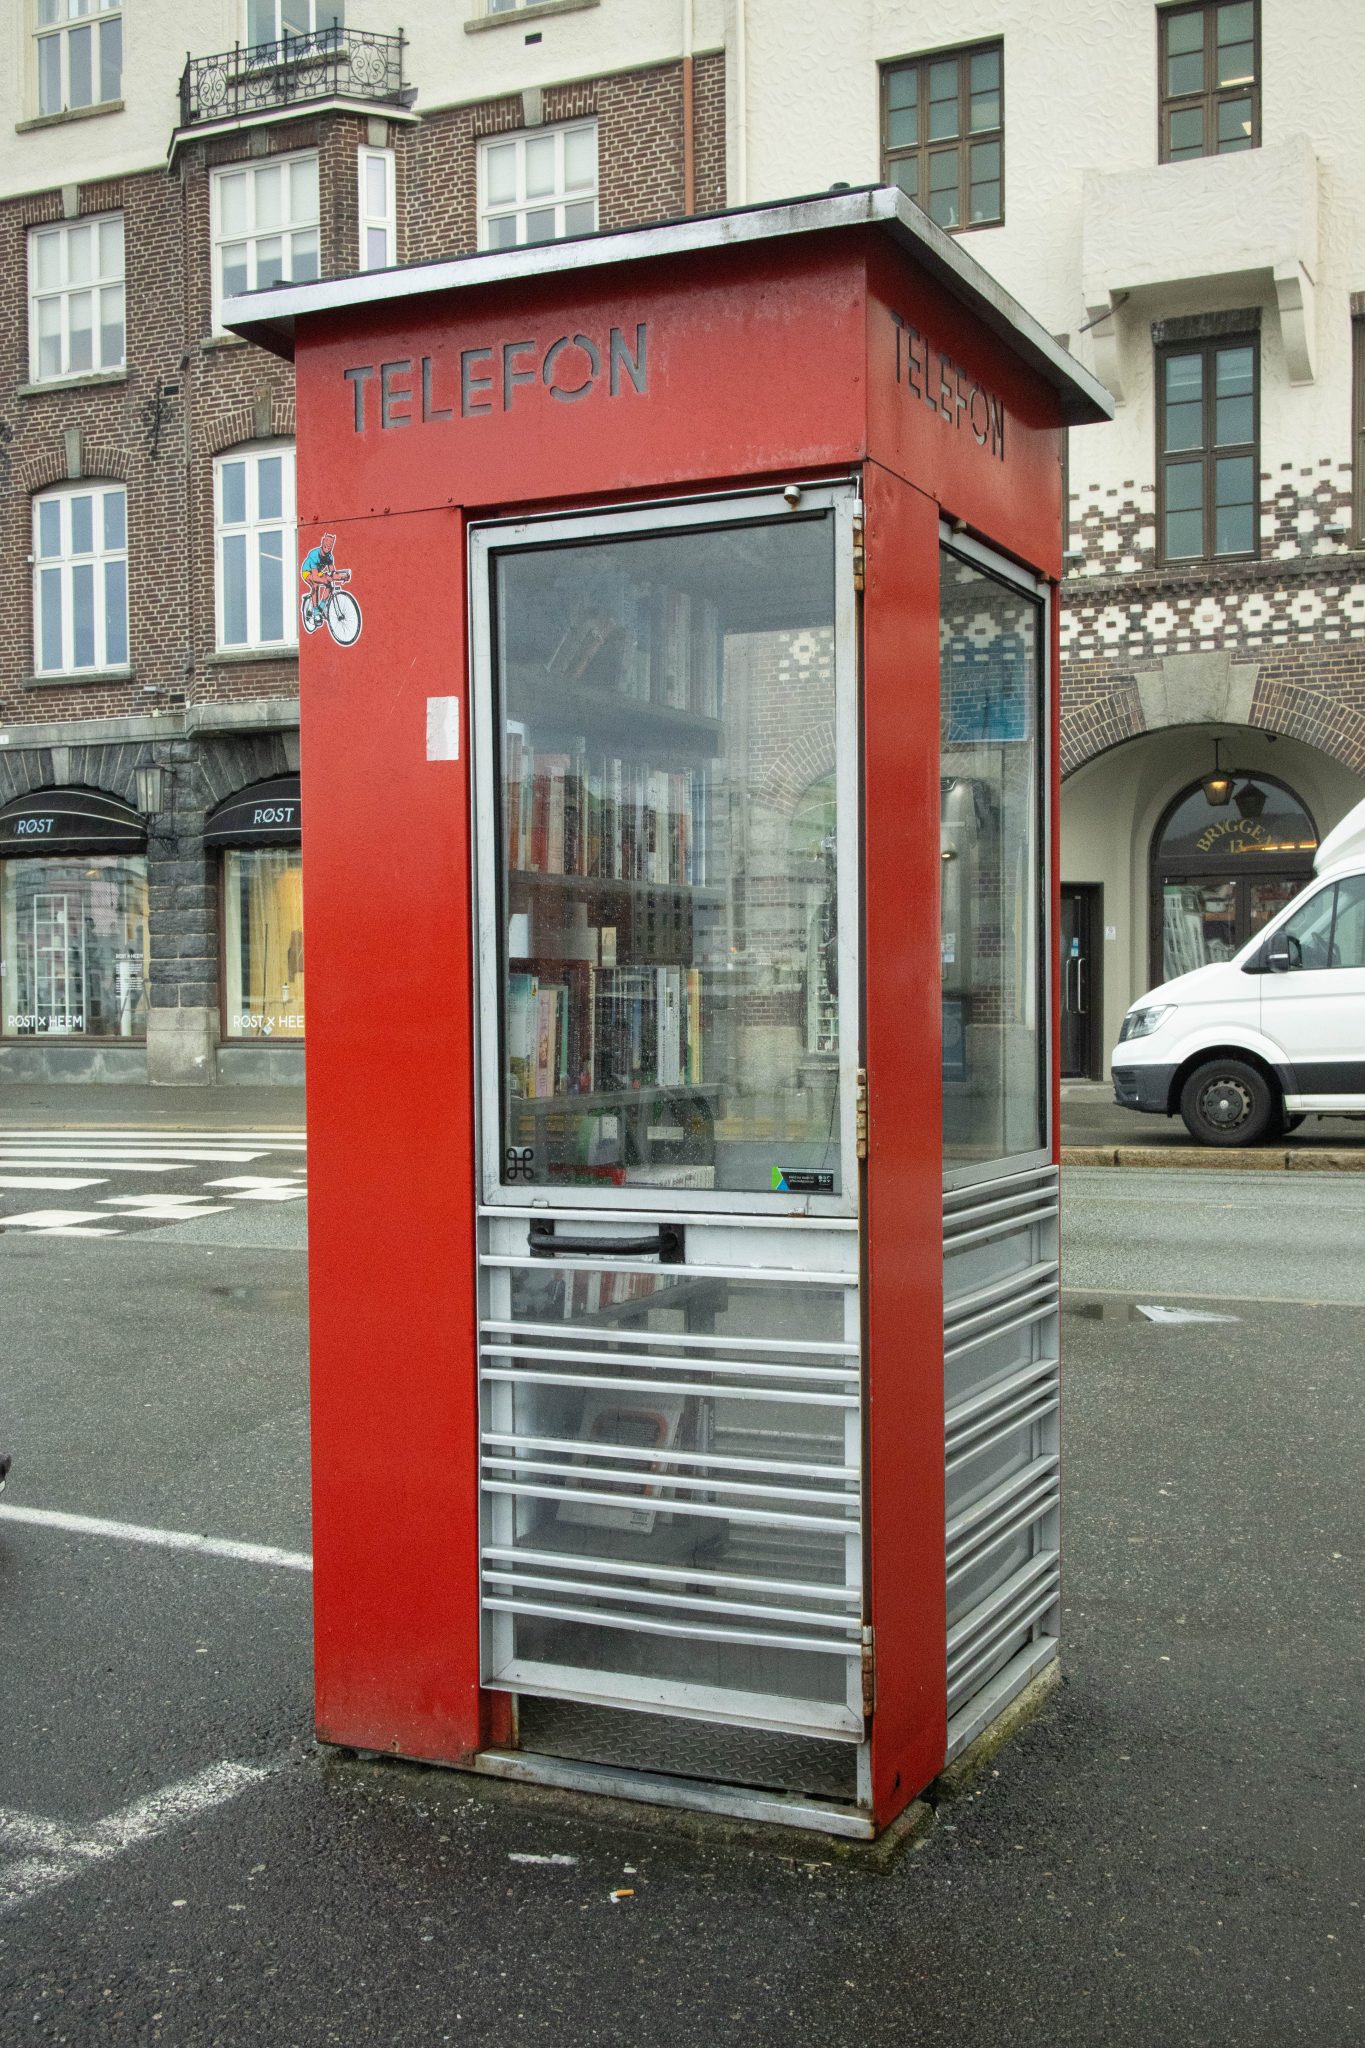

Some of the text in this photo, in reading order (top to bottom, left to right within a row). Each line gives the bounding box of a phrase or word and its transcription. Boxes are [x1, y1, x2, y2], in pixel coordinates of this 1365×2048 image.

[344, 322, 647, 433] TELEFON
[890, 309, 1004, 462] TELEFON
[49, 1015, 83, 1028] HEEM
[278, 1015, 305, 1028] HEE
